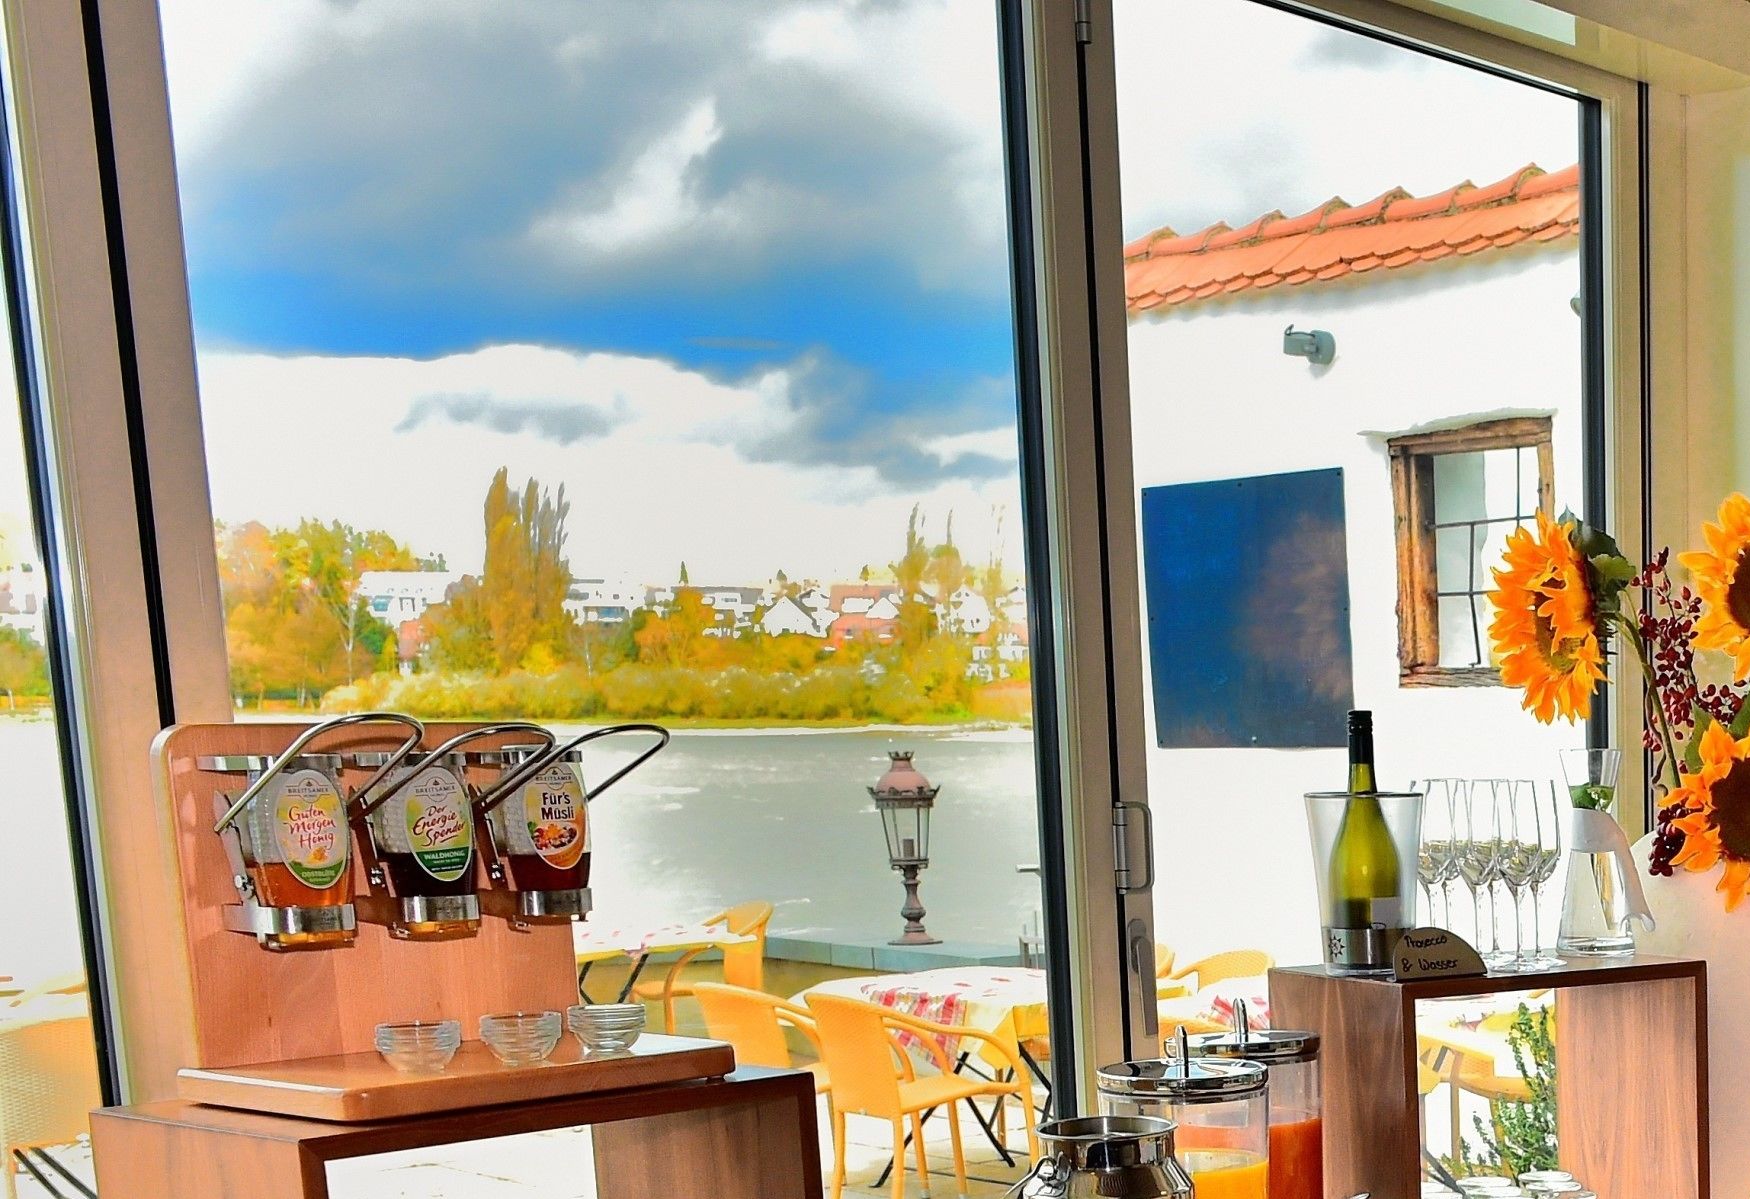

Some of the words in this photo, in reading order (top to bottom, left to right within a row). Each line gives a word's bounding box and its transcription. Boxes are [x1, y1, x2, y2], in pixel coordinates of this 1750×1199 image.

[542, 791, 571, 805] Für's
[288, 804, 325, 821] Guten
[426, 805, 448, 816] Der
[541, 806, 574, 820] Müsli
[284, 819, 336, 835] Morgen
[412, 811, 457, 836] Energie
[299, 832, 334, 850] Honig
[421, 821, 465, 847] Spender
[1404, 935, 1447, 948] Prosecco
[1401, 957, 1413, 972] &
[1417, 958, 1458, 971] Wasser
